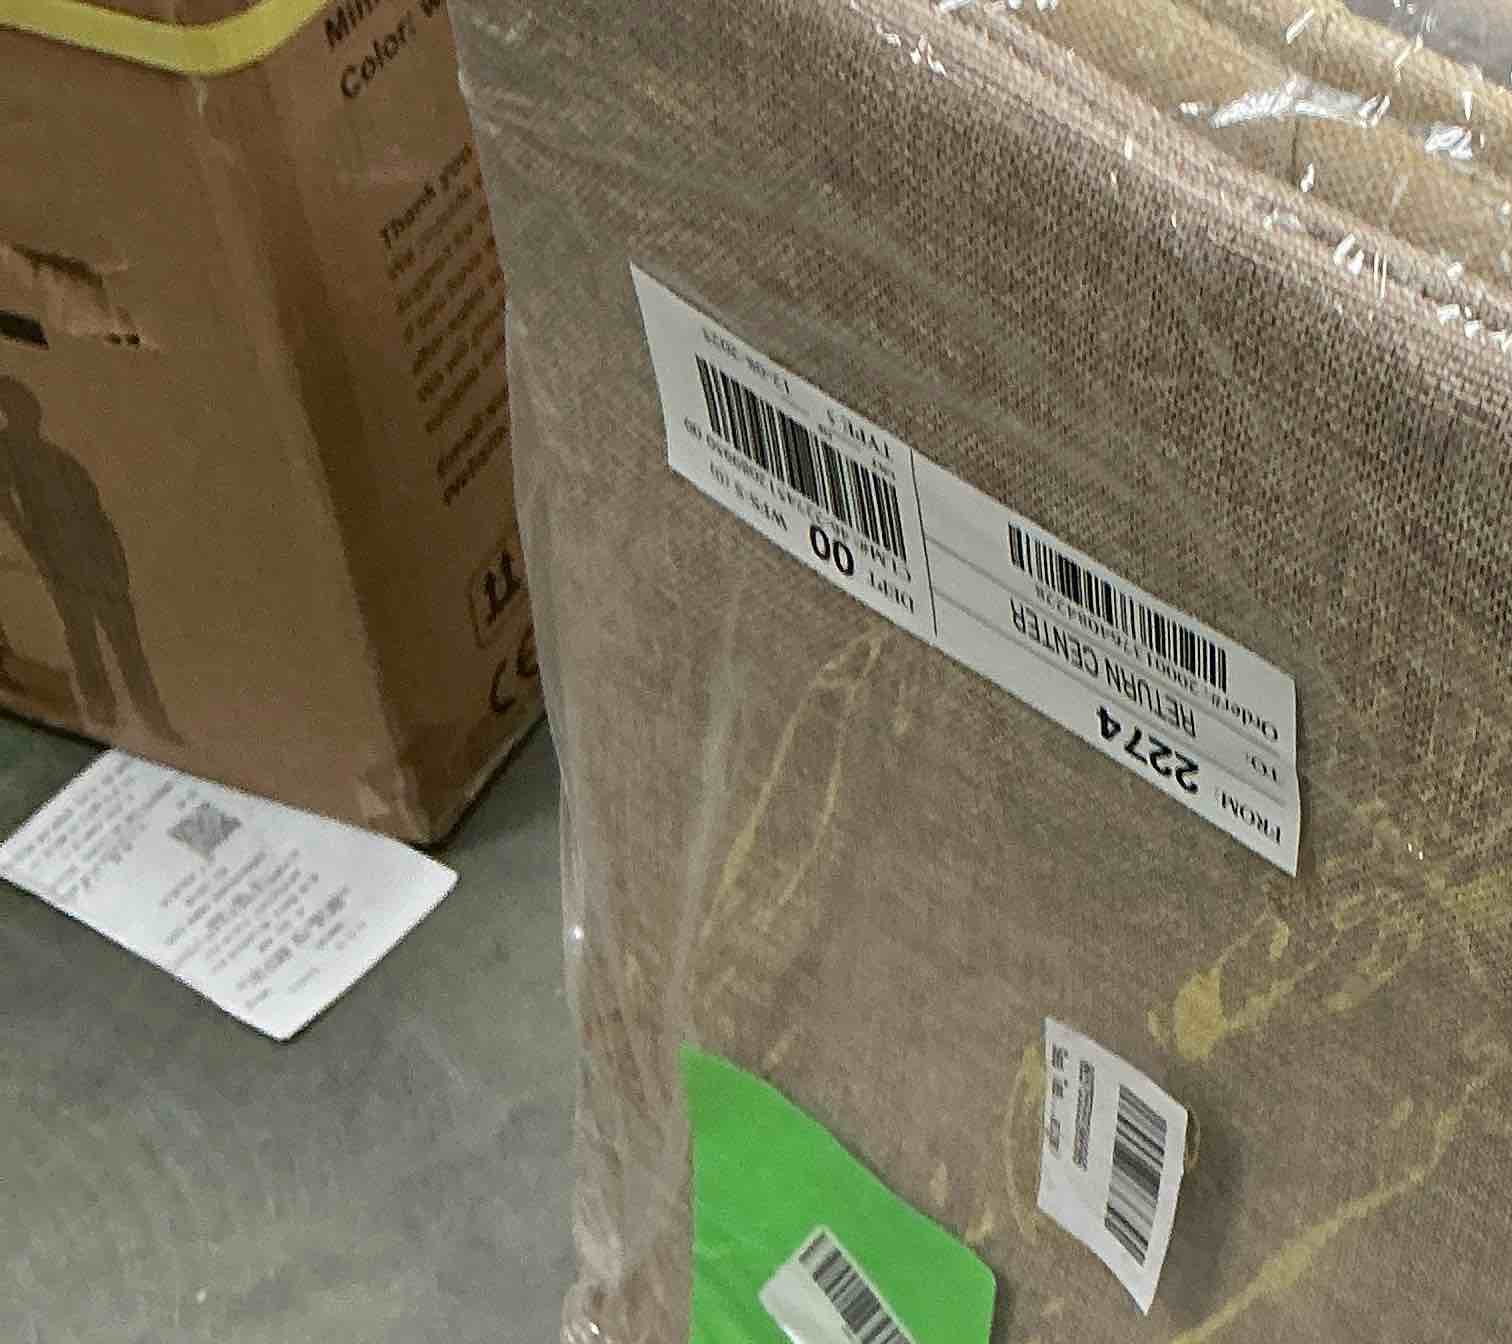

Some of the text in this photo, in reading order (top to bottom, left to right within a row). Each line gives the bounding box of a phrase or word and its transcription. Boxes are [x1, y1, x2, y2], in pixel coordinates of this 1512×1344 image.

[809, 524, 855, 577] 00
[1008, 598, 1099, 678] CENTER
[1104, 656, 1197, 738] RETURN
[1096, 704, 1199, 795] 2274
